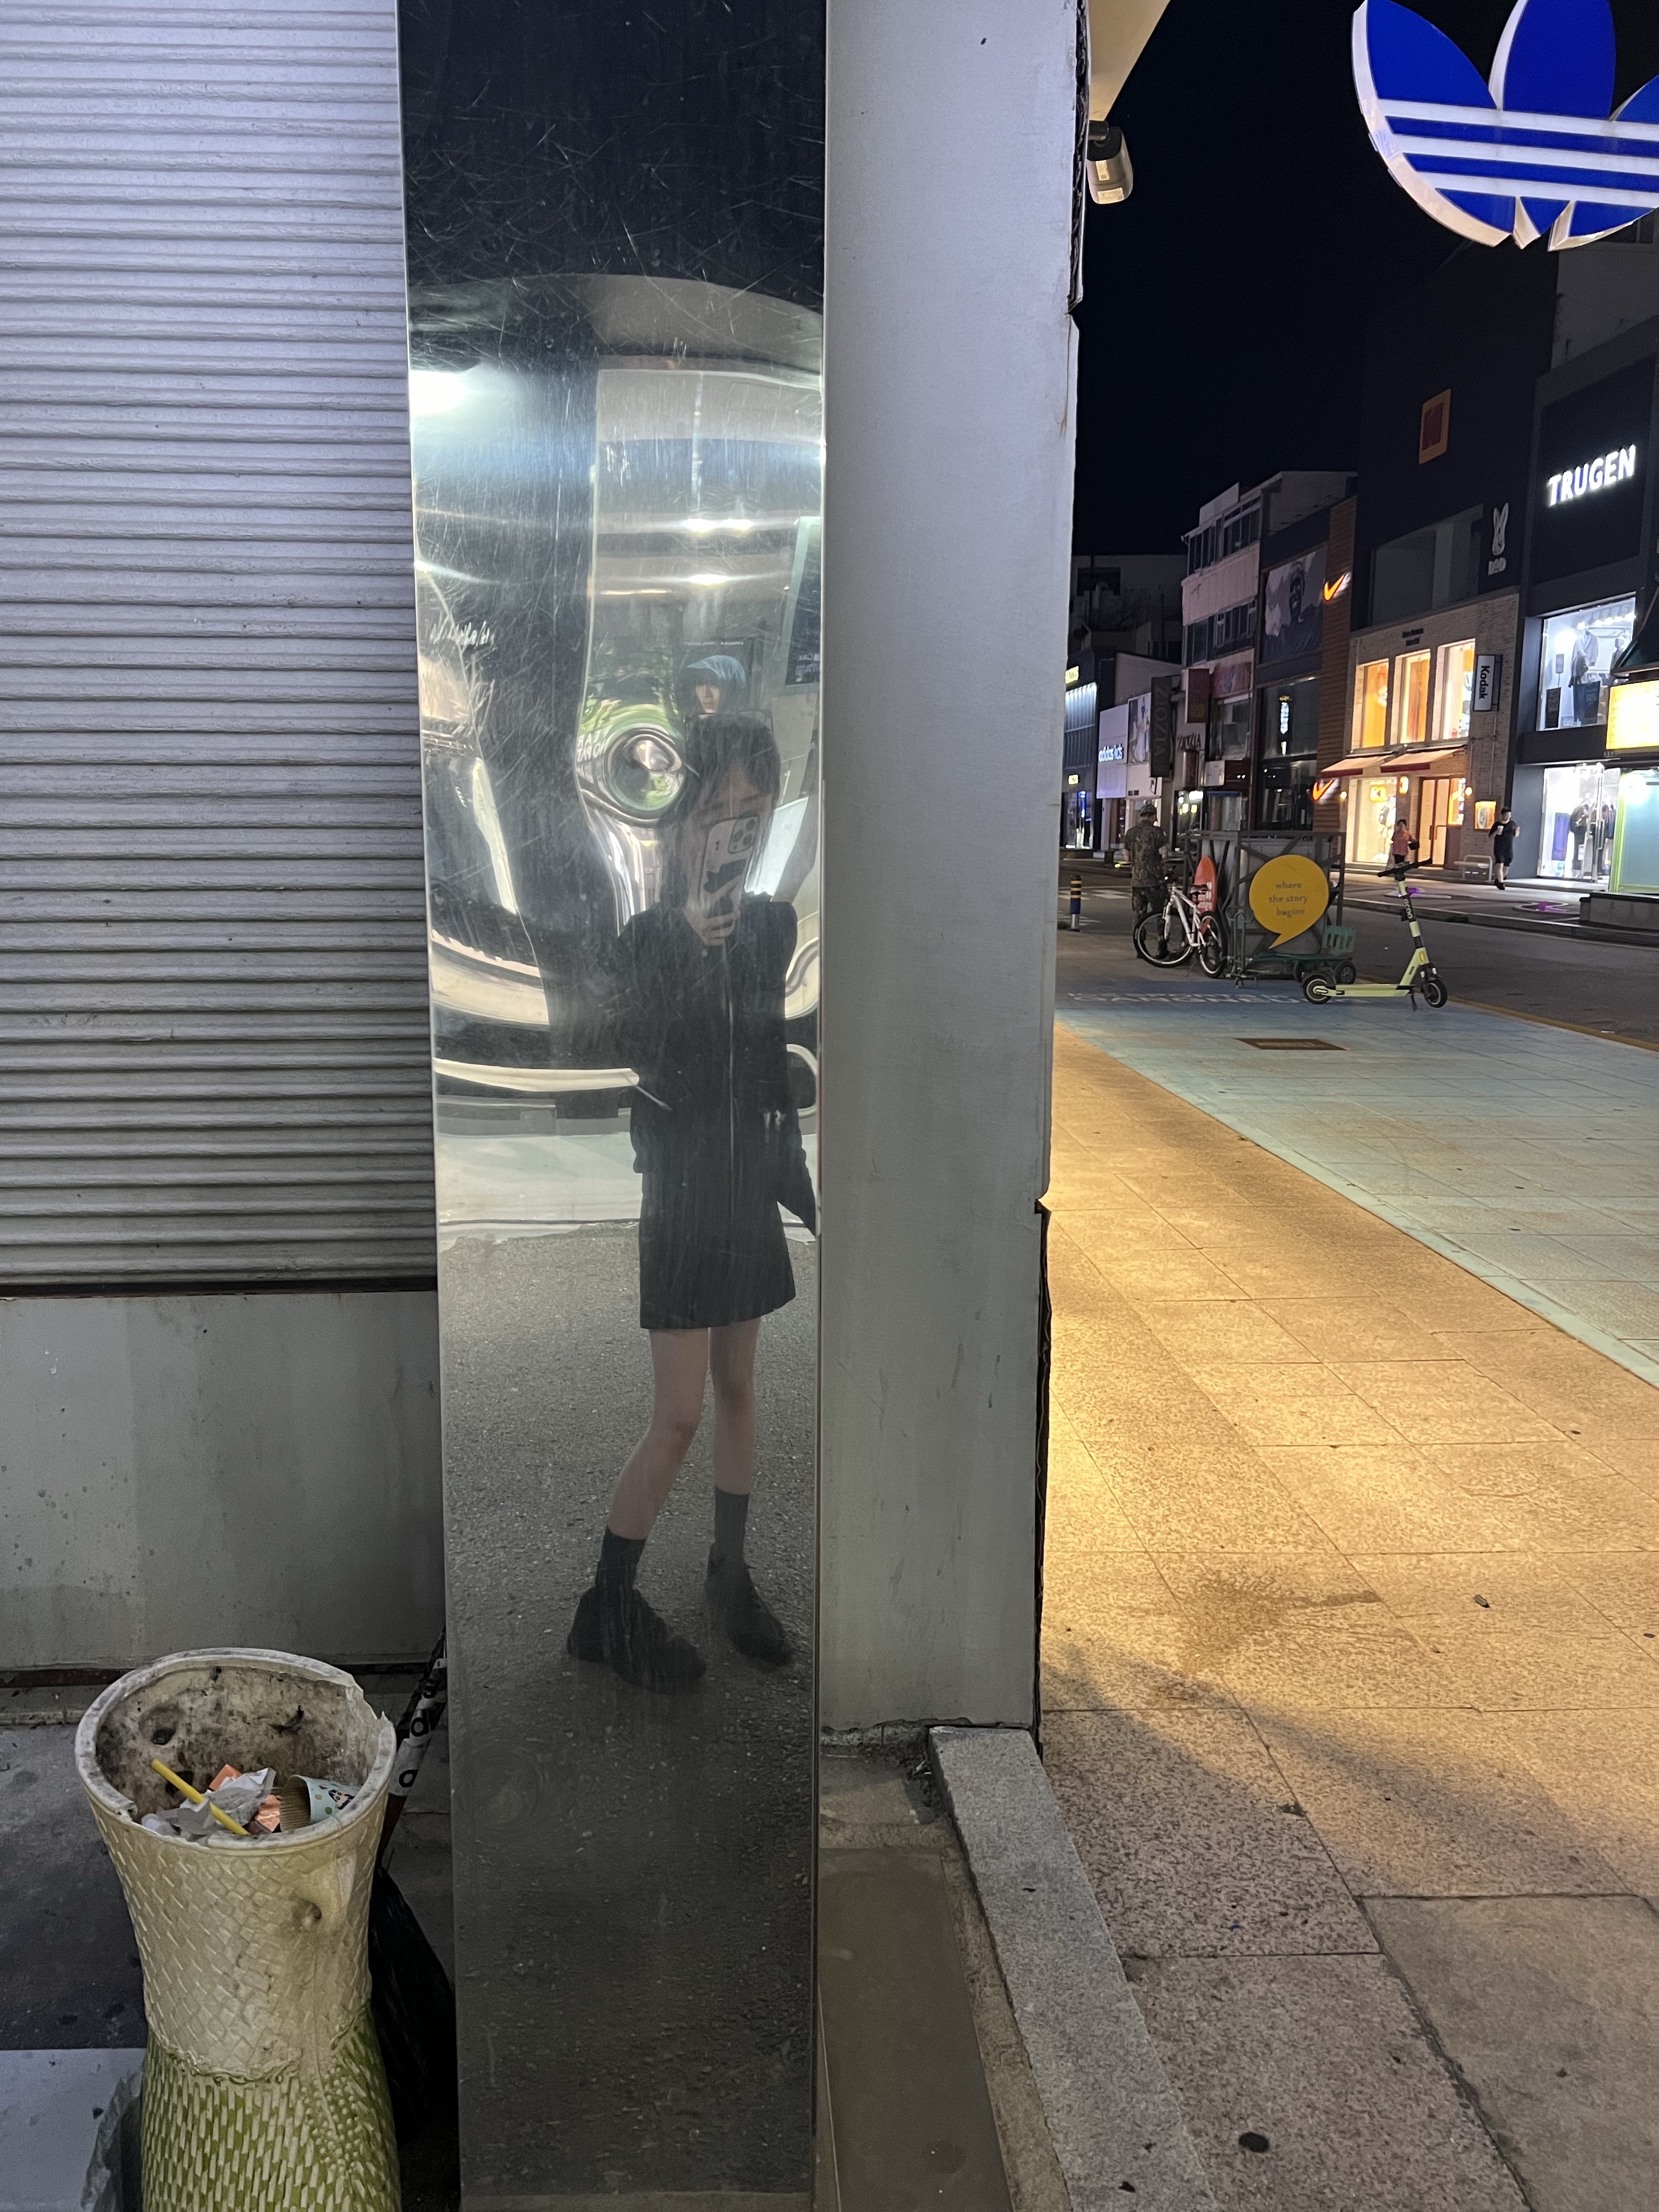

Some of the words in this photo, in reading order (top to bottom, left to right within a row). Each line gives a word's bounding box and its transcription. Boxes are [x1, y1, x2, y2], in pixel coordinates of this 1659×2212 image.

[1548, 444, 1637, 506] TRUGEN
[1479, 665, 1490, 699] Kodak
[1276, 881, 1302, 889] where
[1269, 894, 1283, 902] the
[1286, 896, 1307, 904] story
[1277, 907, 1304, 918] begins
